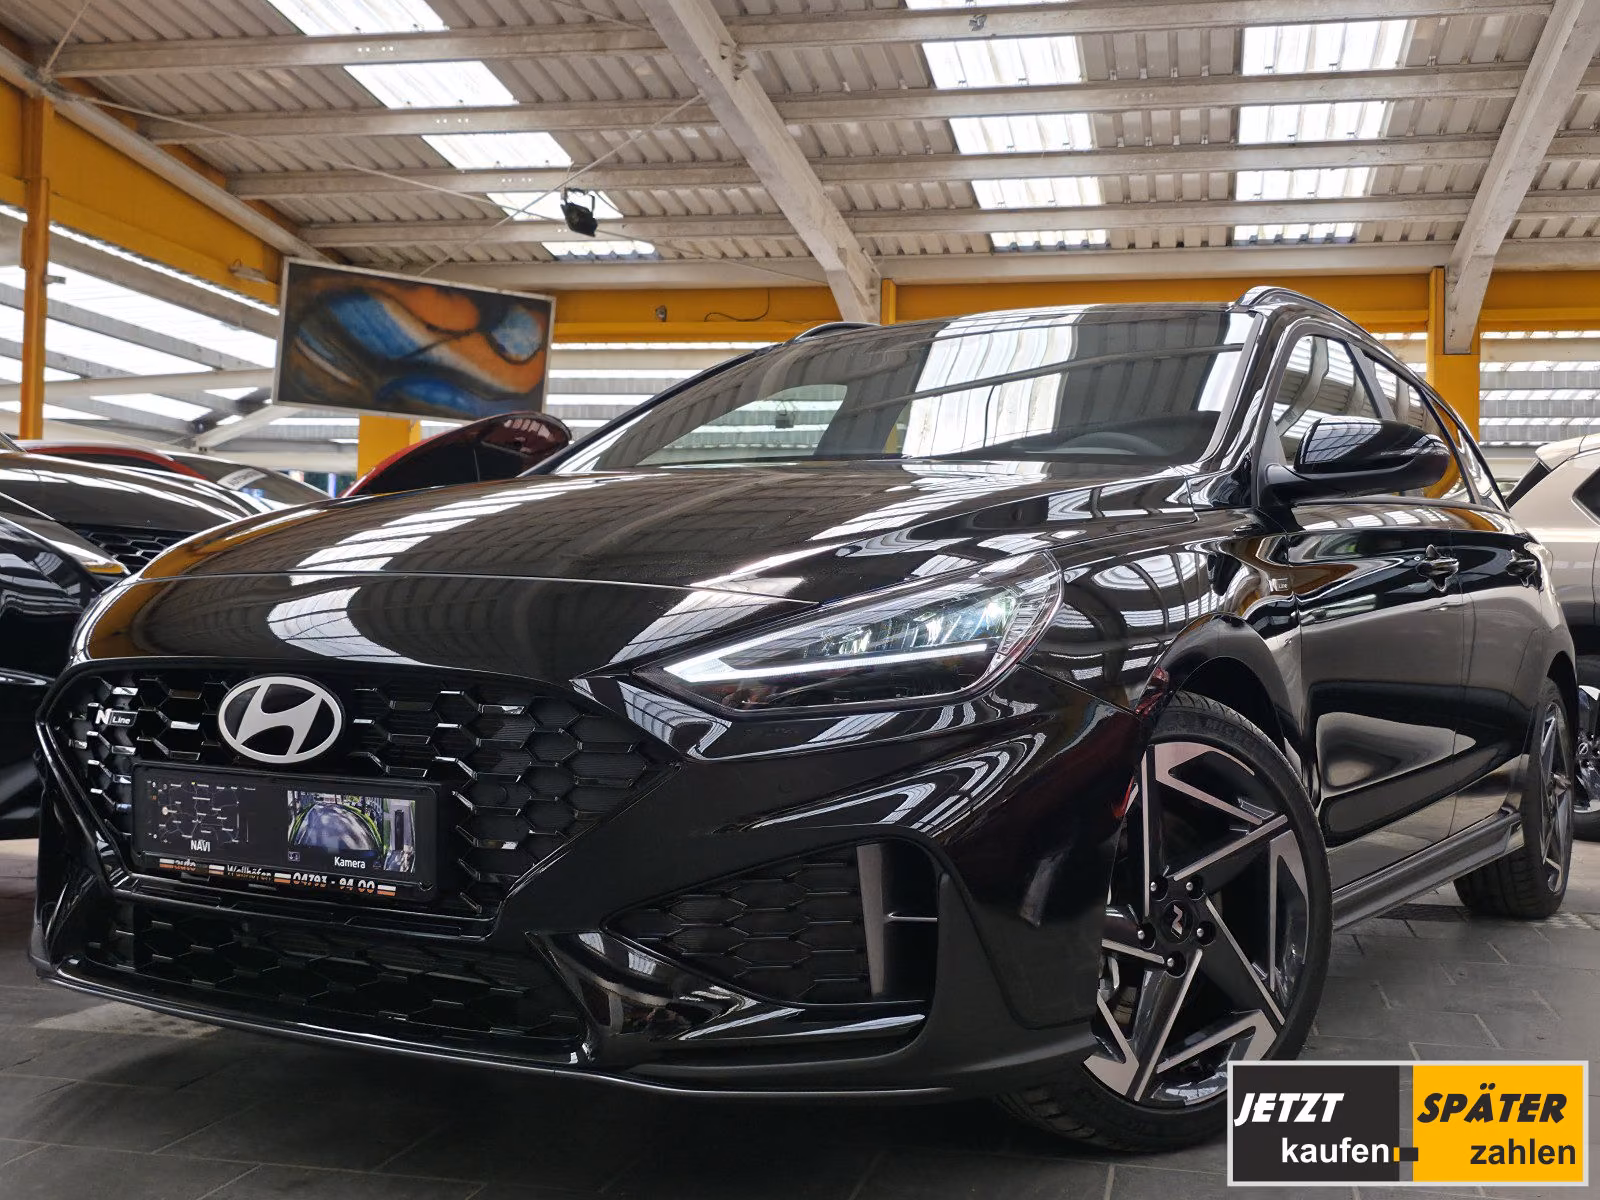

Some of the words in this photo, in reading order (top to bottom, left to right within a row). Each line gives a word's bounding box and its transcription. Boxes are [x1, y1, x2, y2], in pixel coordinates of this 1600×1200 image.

[95, 708, 112, 725] N
[190, 839, 211, 852] NAVI
[334, 856, 366, 869] Kamera
